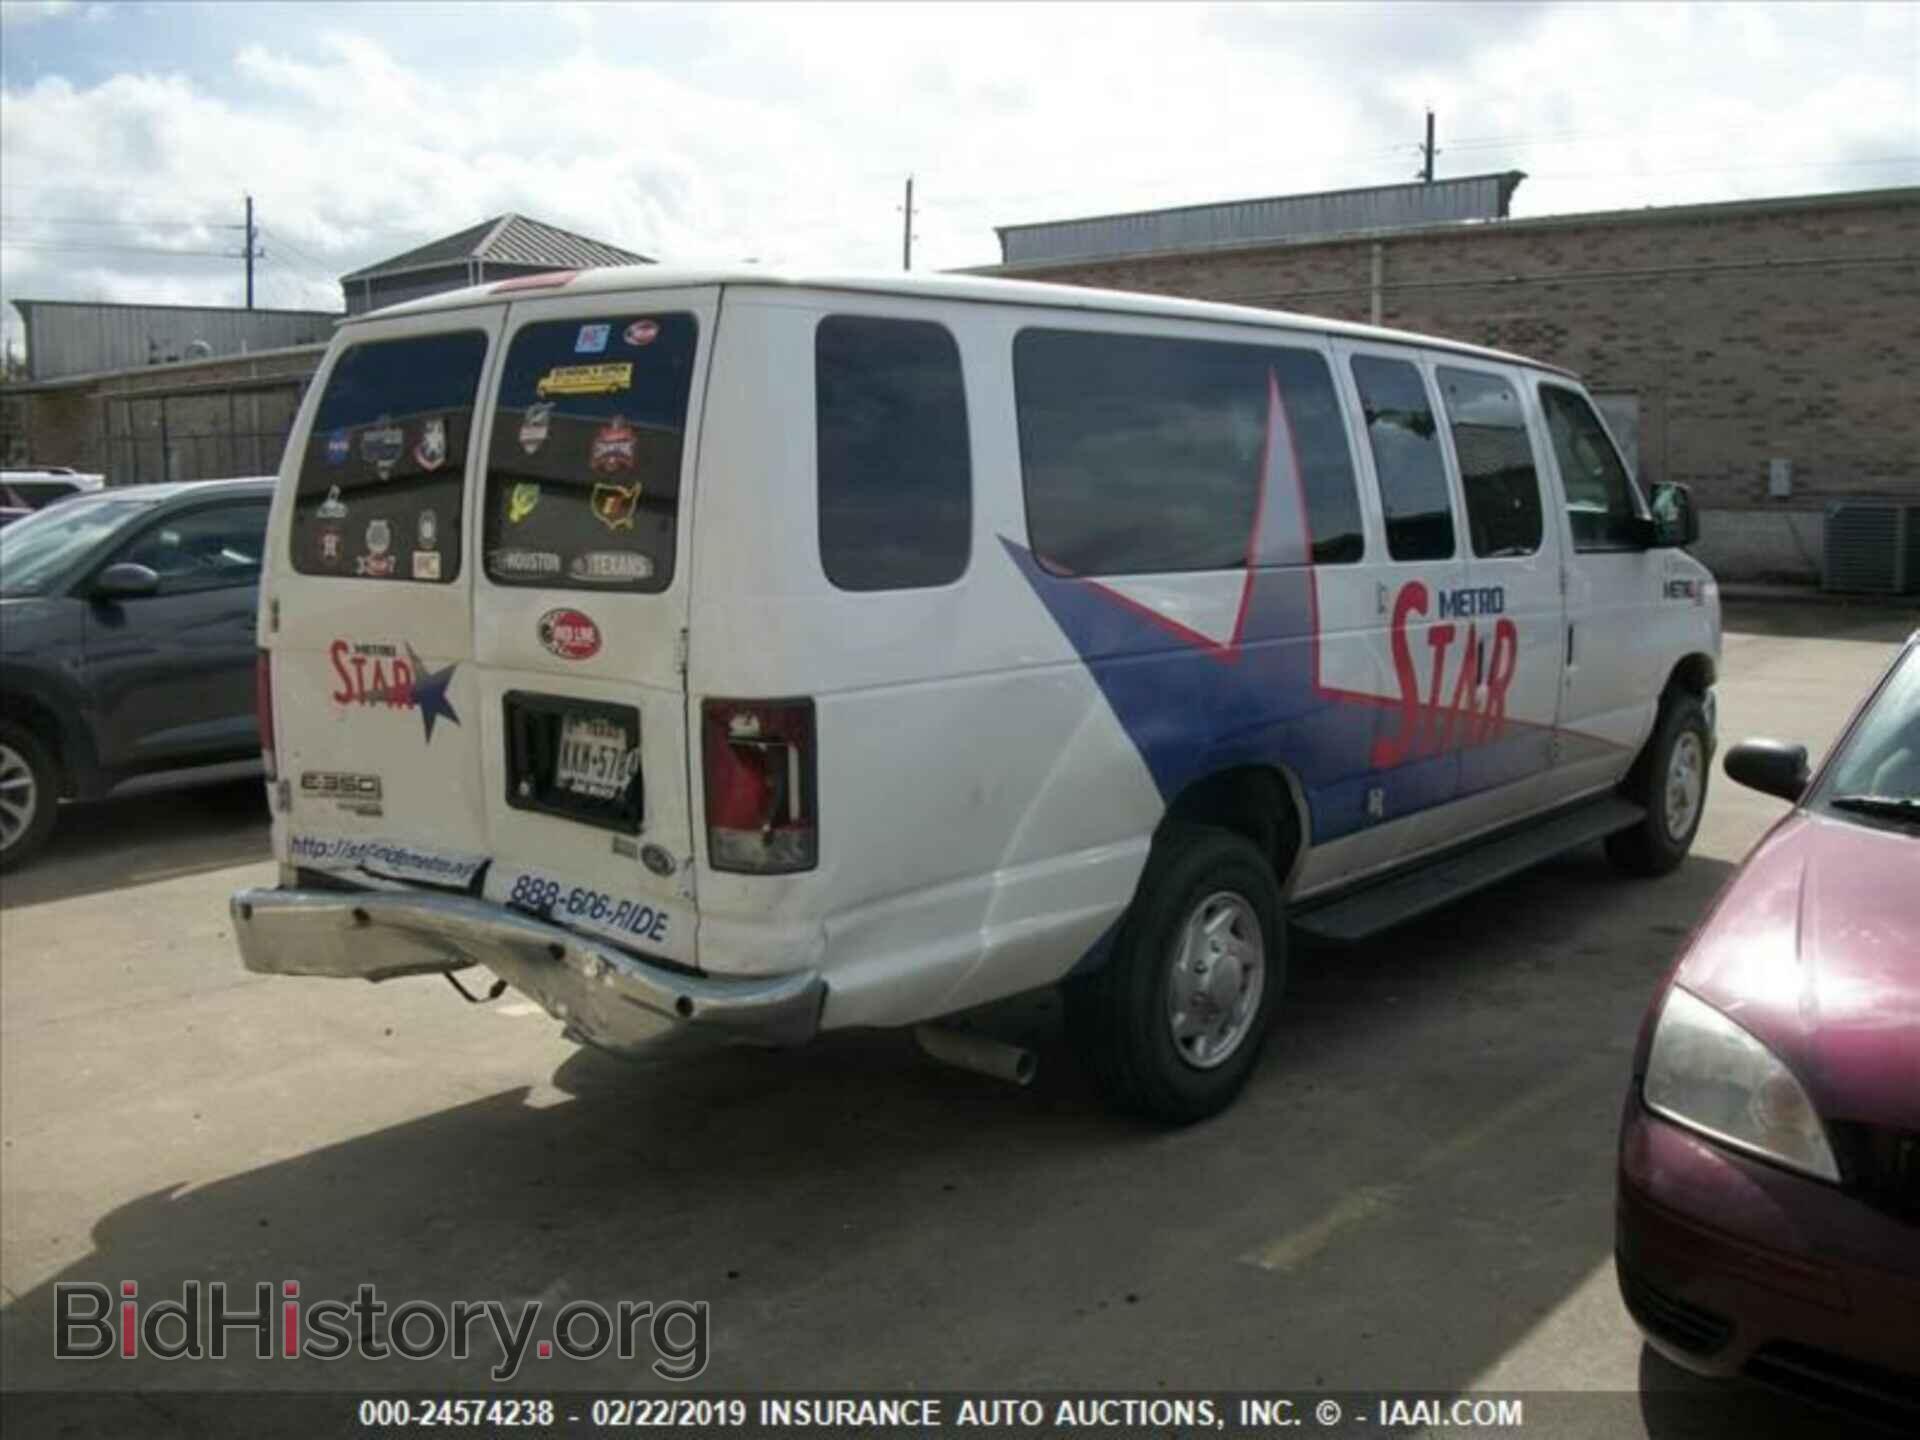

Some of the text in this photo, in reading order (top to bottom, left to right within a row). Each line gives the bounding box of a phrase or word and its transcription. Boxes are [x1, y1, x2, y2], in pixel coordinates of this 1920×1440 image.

[507, 553, 561, 573] HOUSTON
[1438, 587, 1504, 618] METRO
[330, 639, 416, 711] STAR
[1370, 580, 1518, 769] STAR
[511, 874, 668, 942] 888-606-RIDE
